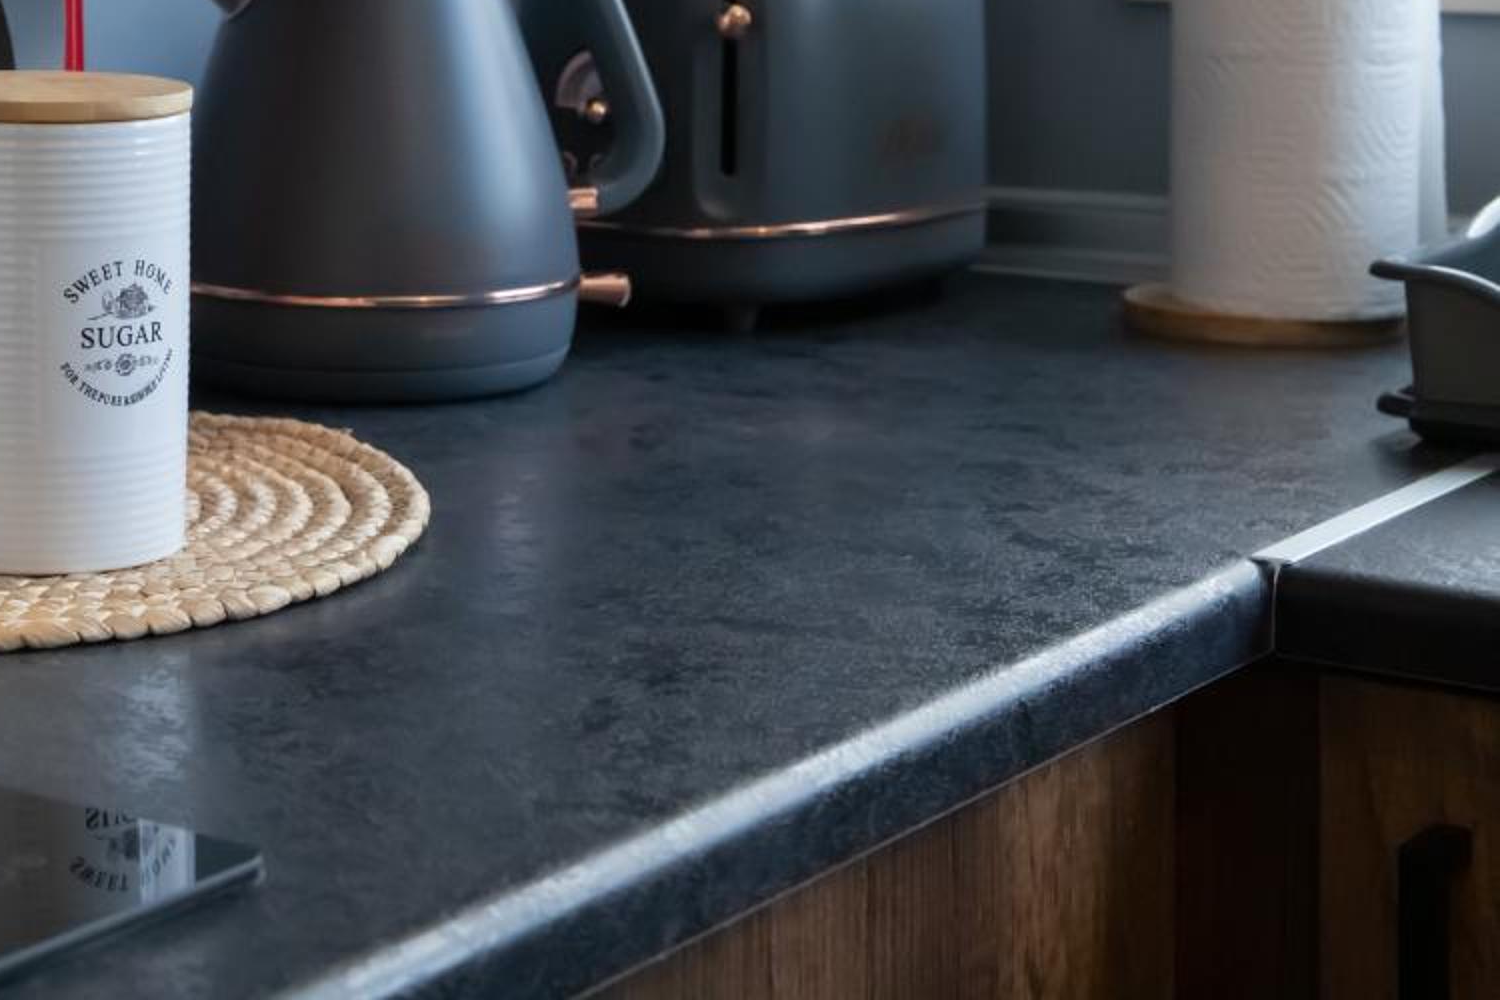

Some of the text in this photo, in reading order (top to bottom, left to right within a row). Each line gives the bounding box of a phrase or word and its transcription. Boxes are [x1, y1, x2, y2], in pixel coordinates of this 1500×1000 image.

[63, 259, 173, 304] SWEET HOME
[81, 321, 163, 349] SUGAR
